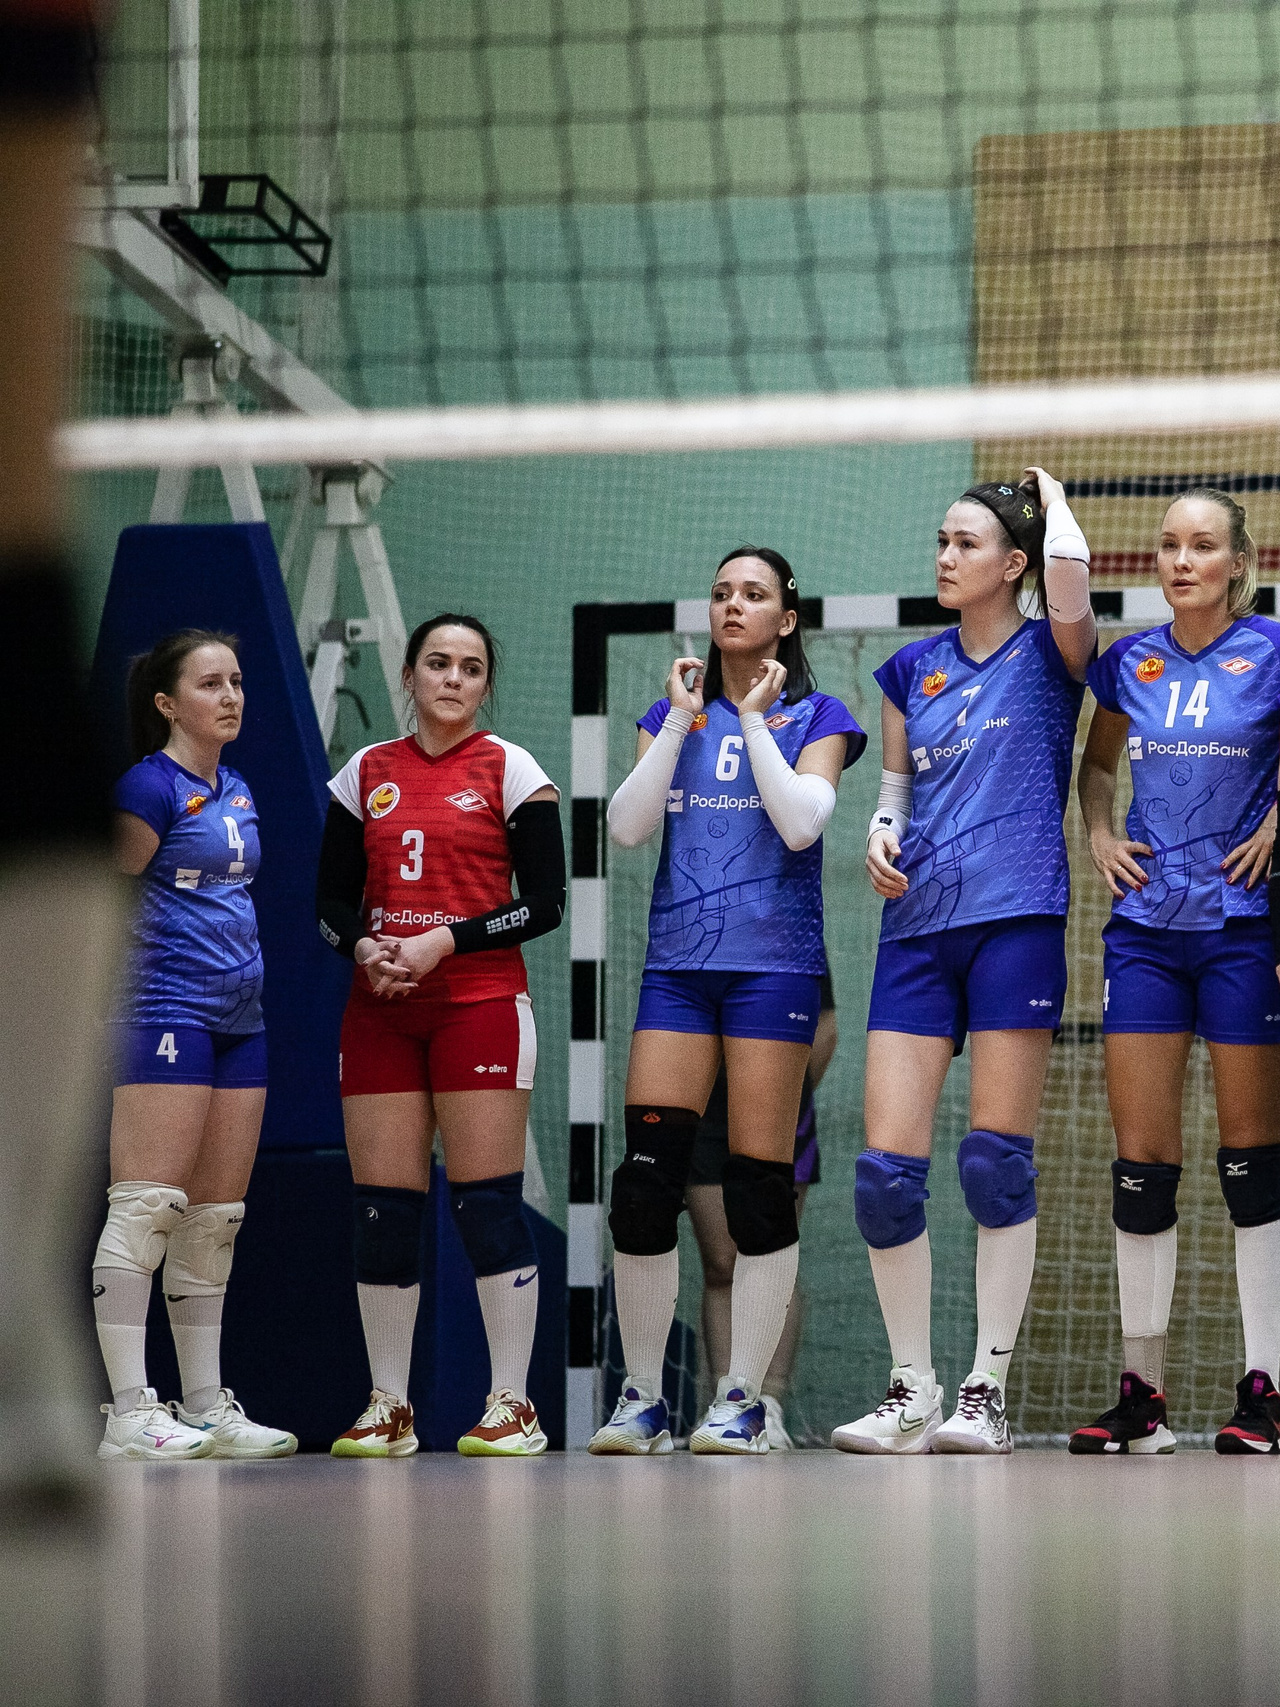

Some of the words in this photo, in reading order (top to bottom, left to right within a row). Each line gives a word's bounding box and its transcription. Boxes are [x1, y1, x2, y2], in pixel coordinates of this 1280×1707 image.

[1164, 680, 1210, 728] 14
[715, 735, 744, 781] 6
[1148, 741, 1250, 758] РосДорБанк
[222, 816, 245, 861] 4
[400, 829, 424, 881] 3
[156, 1032, 179, 1063] 4
